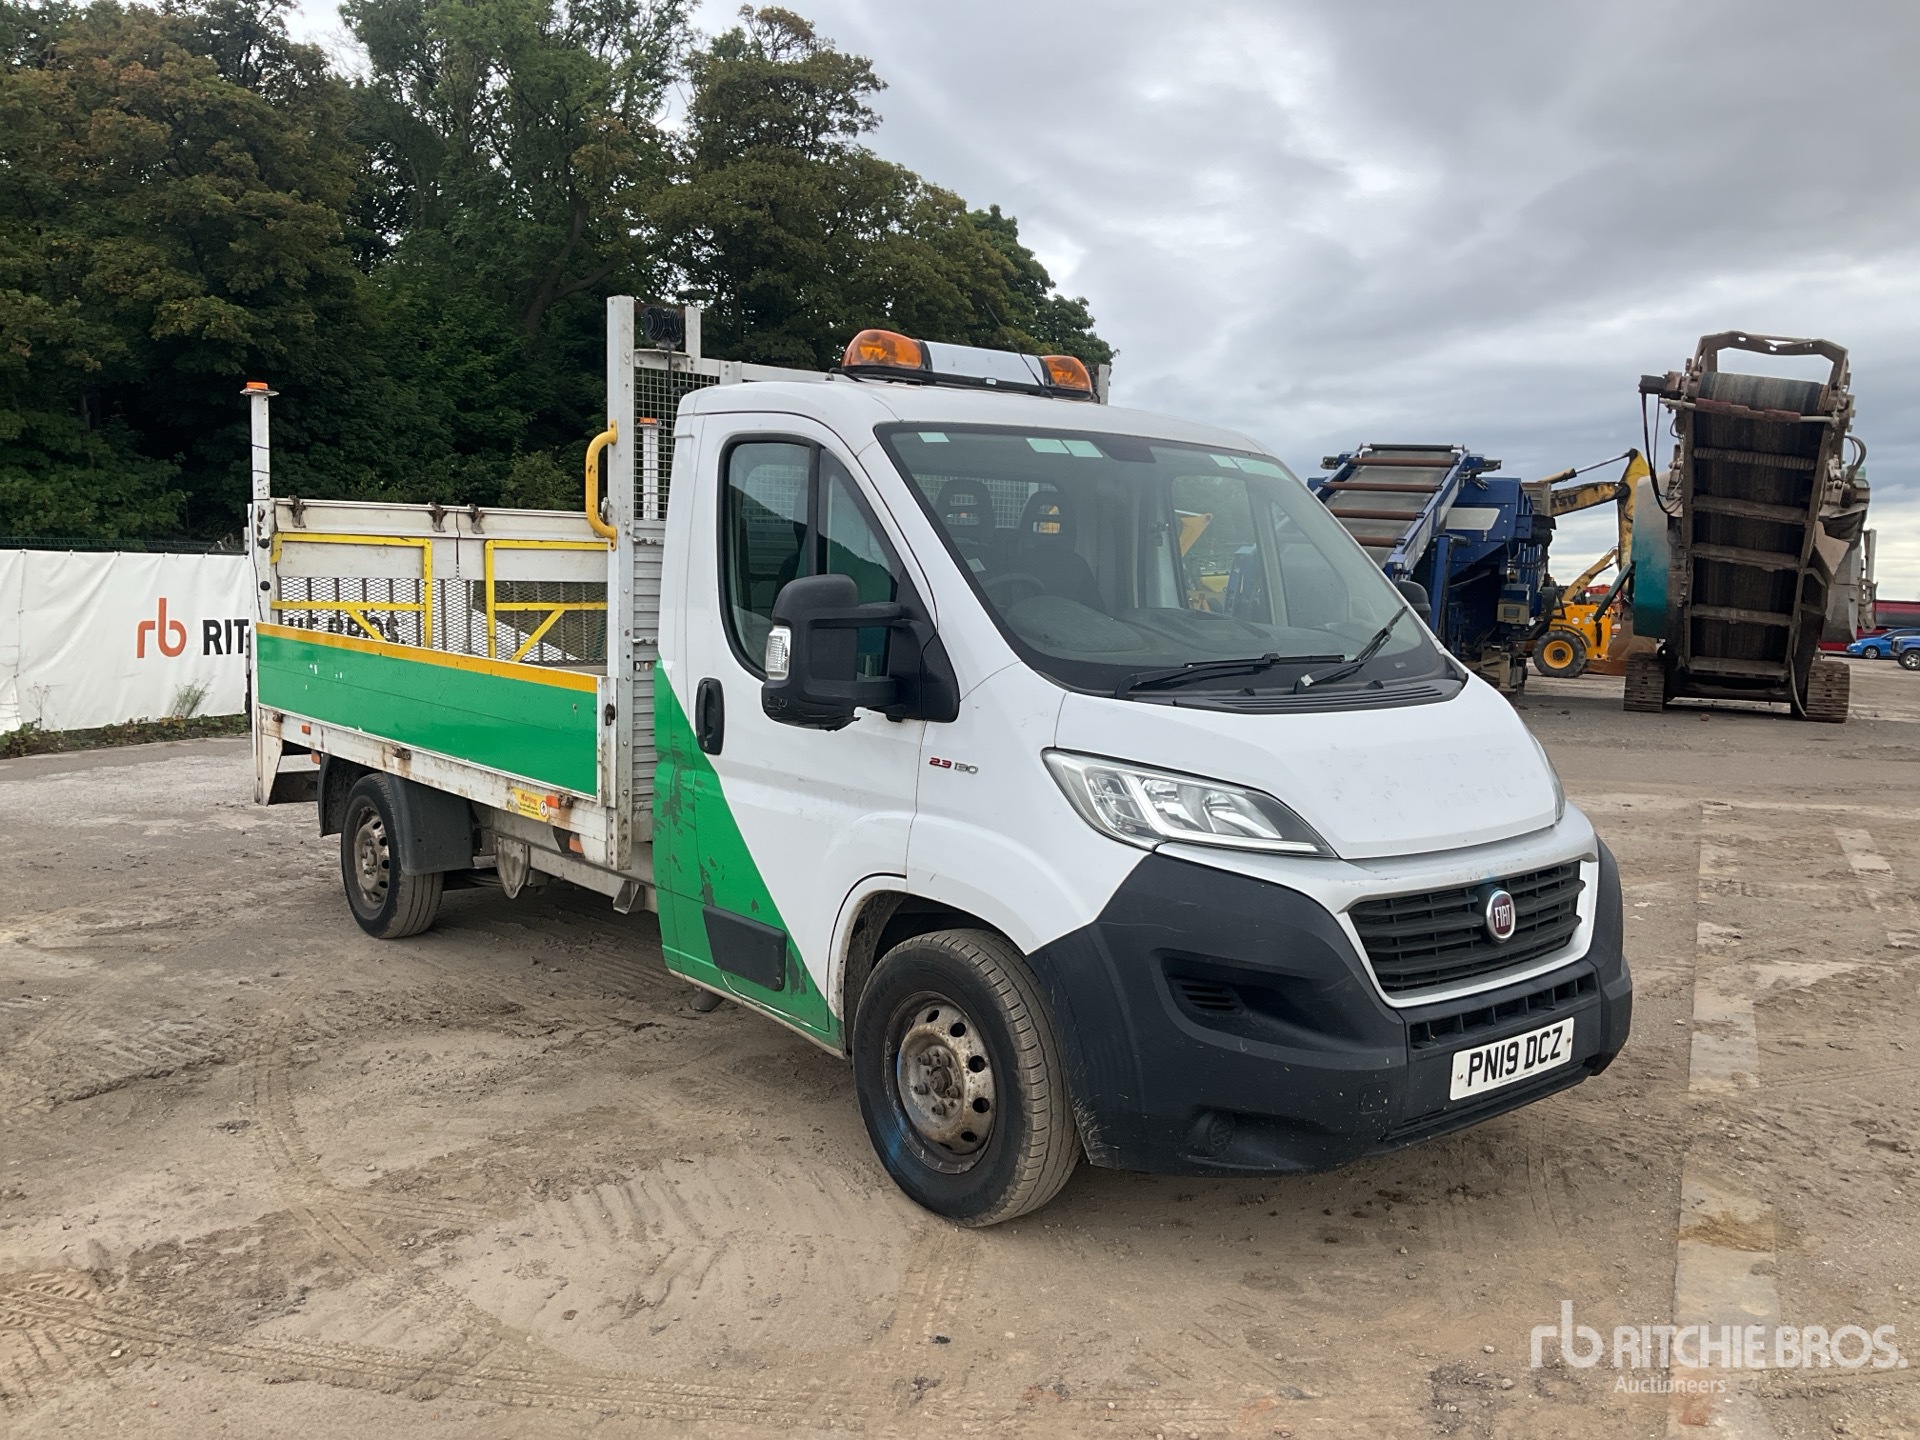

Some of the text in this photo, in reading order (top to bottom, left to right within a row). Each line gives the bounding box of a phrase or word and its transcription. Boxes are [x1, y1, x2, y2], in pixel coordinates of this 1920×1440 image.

[136, 597, 187, 658] rb
[954, 762, 979, 775] 130
[1494, 904, 1511, 928] FIAT
[1467, 1025, 1563, 1087] PN19 DCZ
